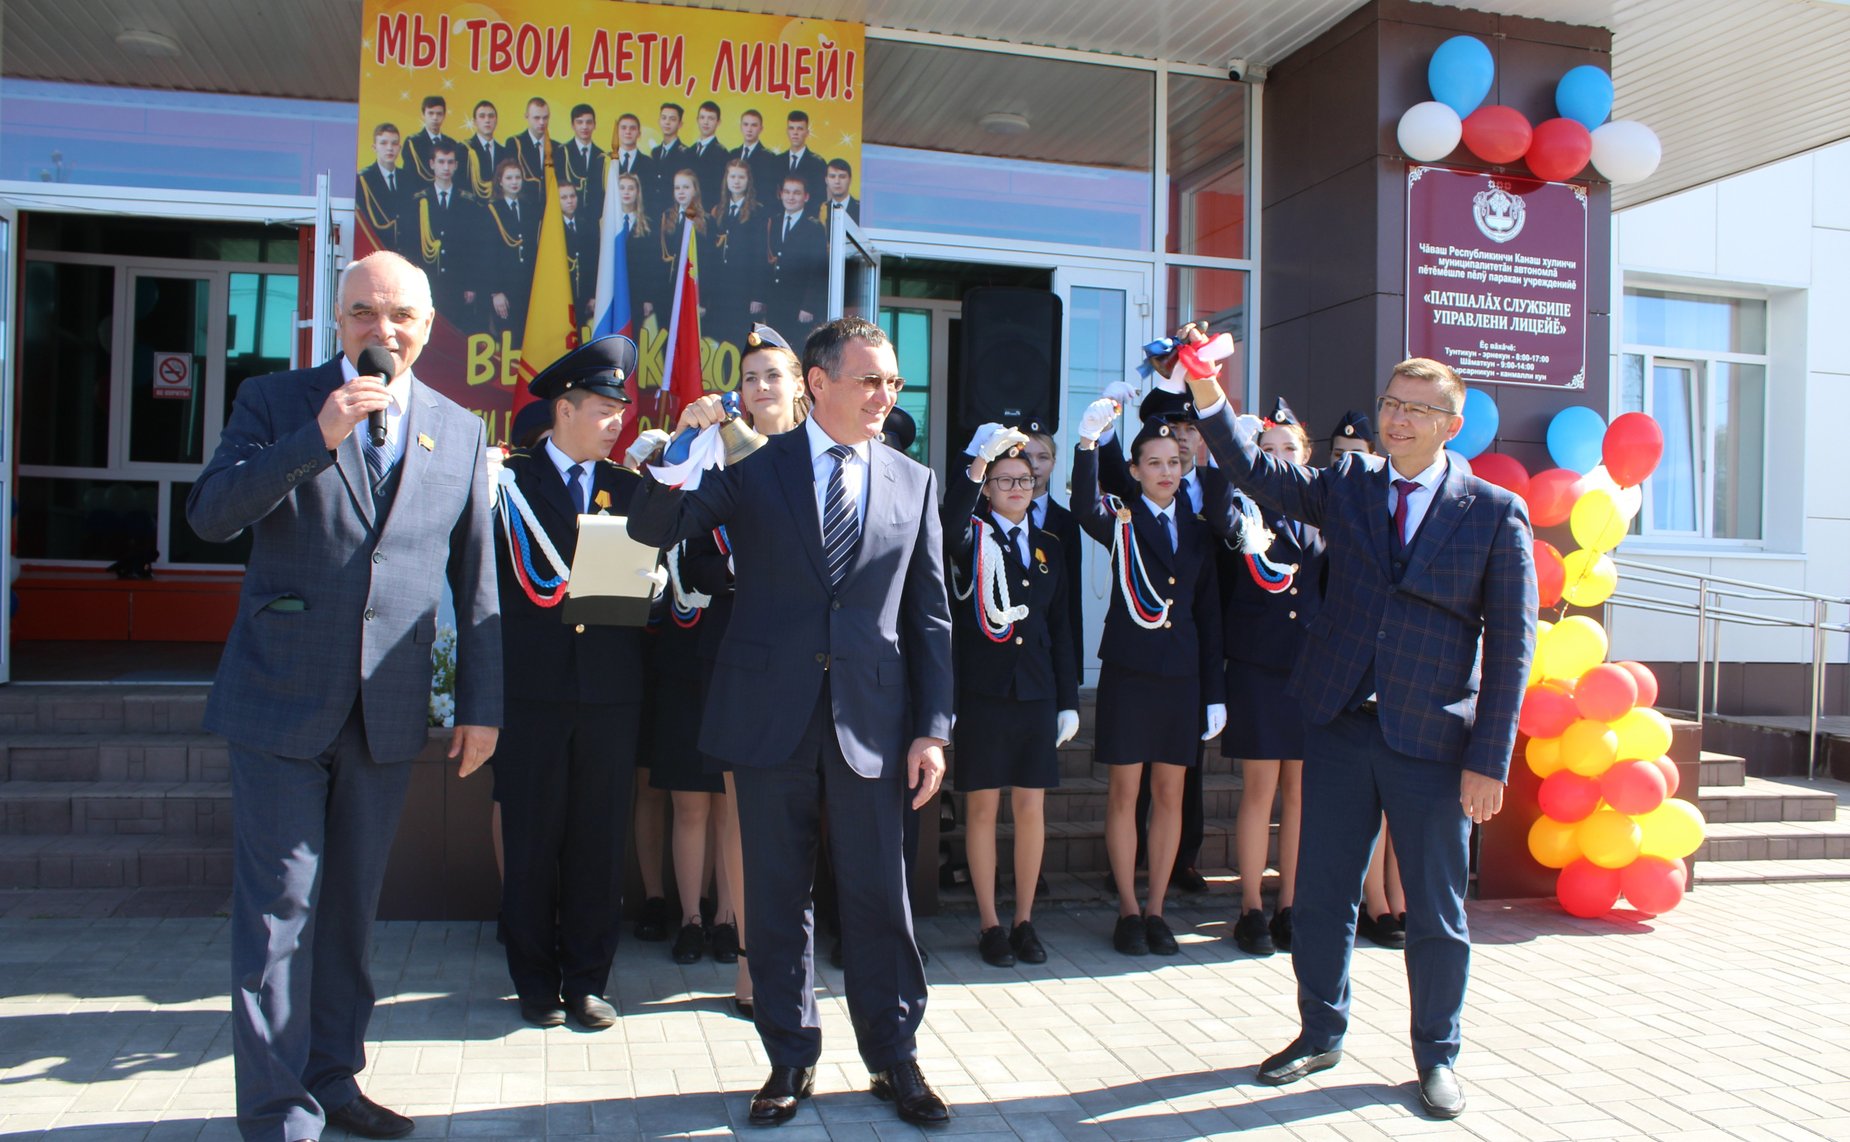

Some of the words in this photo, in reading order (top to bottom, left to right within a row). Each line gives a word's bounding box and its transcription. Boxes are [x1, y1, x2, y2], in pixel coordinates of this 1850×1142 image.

[376, 13, 448, 69] МЫ
[466, 19, 570, 78] ТВОИ
[584, 30, 696, 96] ДЕТИ,
[712, 40, 856, 100] ЛИЦЕЙ!
[1449, 246, 1513, 263] Республикинчи
[1515, 253, 1541, 266] Канаш
[1542, 257, 1577, 269] хулинчи
[1488, 273, 1522, 285] паракан
[1503, 298, 1571, 317] СЛУЖБИПЕ
[1433, 309, 1508, 331] УПРАВЛЕНИ
[1500, 360, 1535, 371] 9:00-14:00
[1515, 353, 1550, 363] 8:00-17:00
